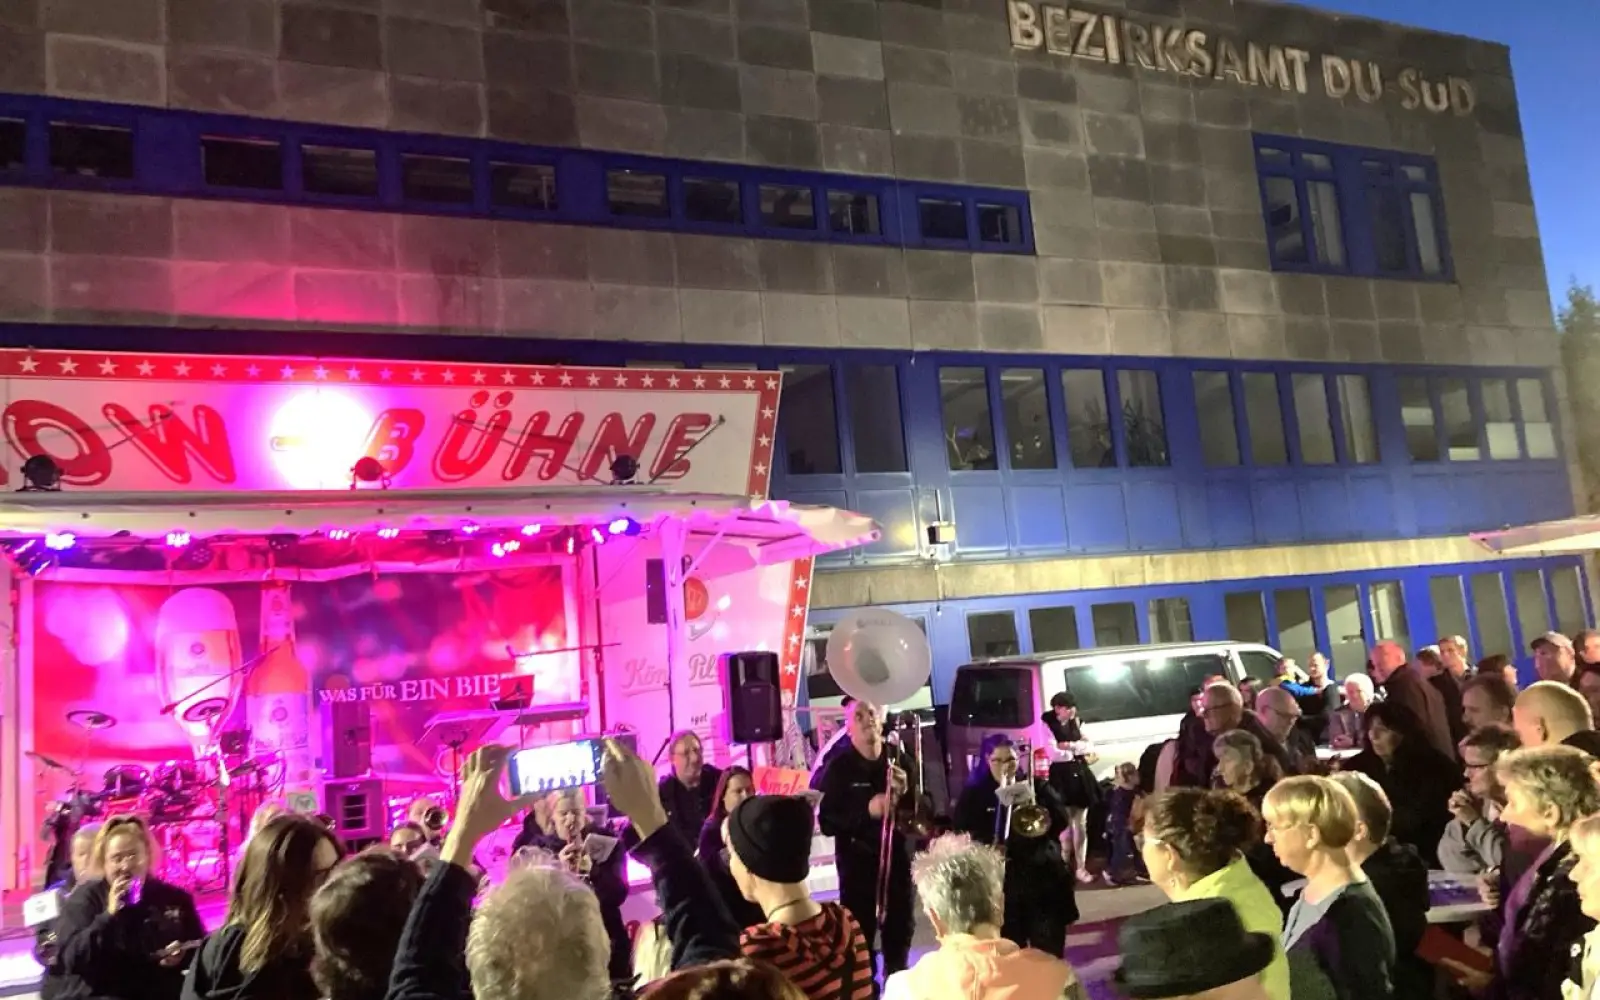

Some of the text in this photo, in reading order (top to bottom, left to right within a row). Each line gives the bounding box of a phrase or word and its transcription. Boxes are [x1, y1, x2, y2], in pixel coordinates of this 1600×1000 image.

[1009, 1, 1309, 94] BEZIRKSAMT
[0, 390, 712, 486] OW BÜHNE
[319, 673, 510, 702] WAS FÜR EIN BIE
[621, 653, 720, 689] Kön Pil
